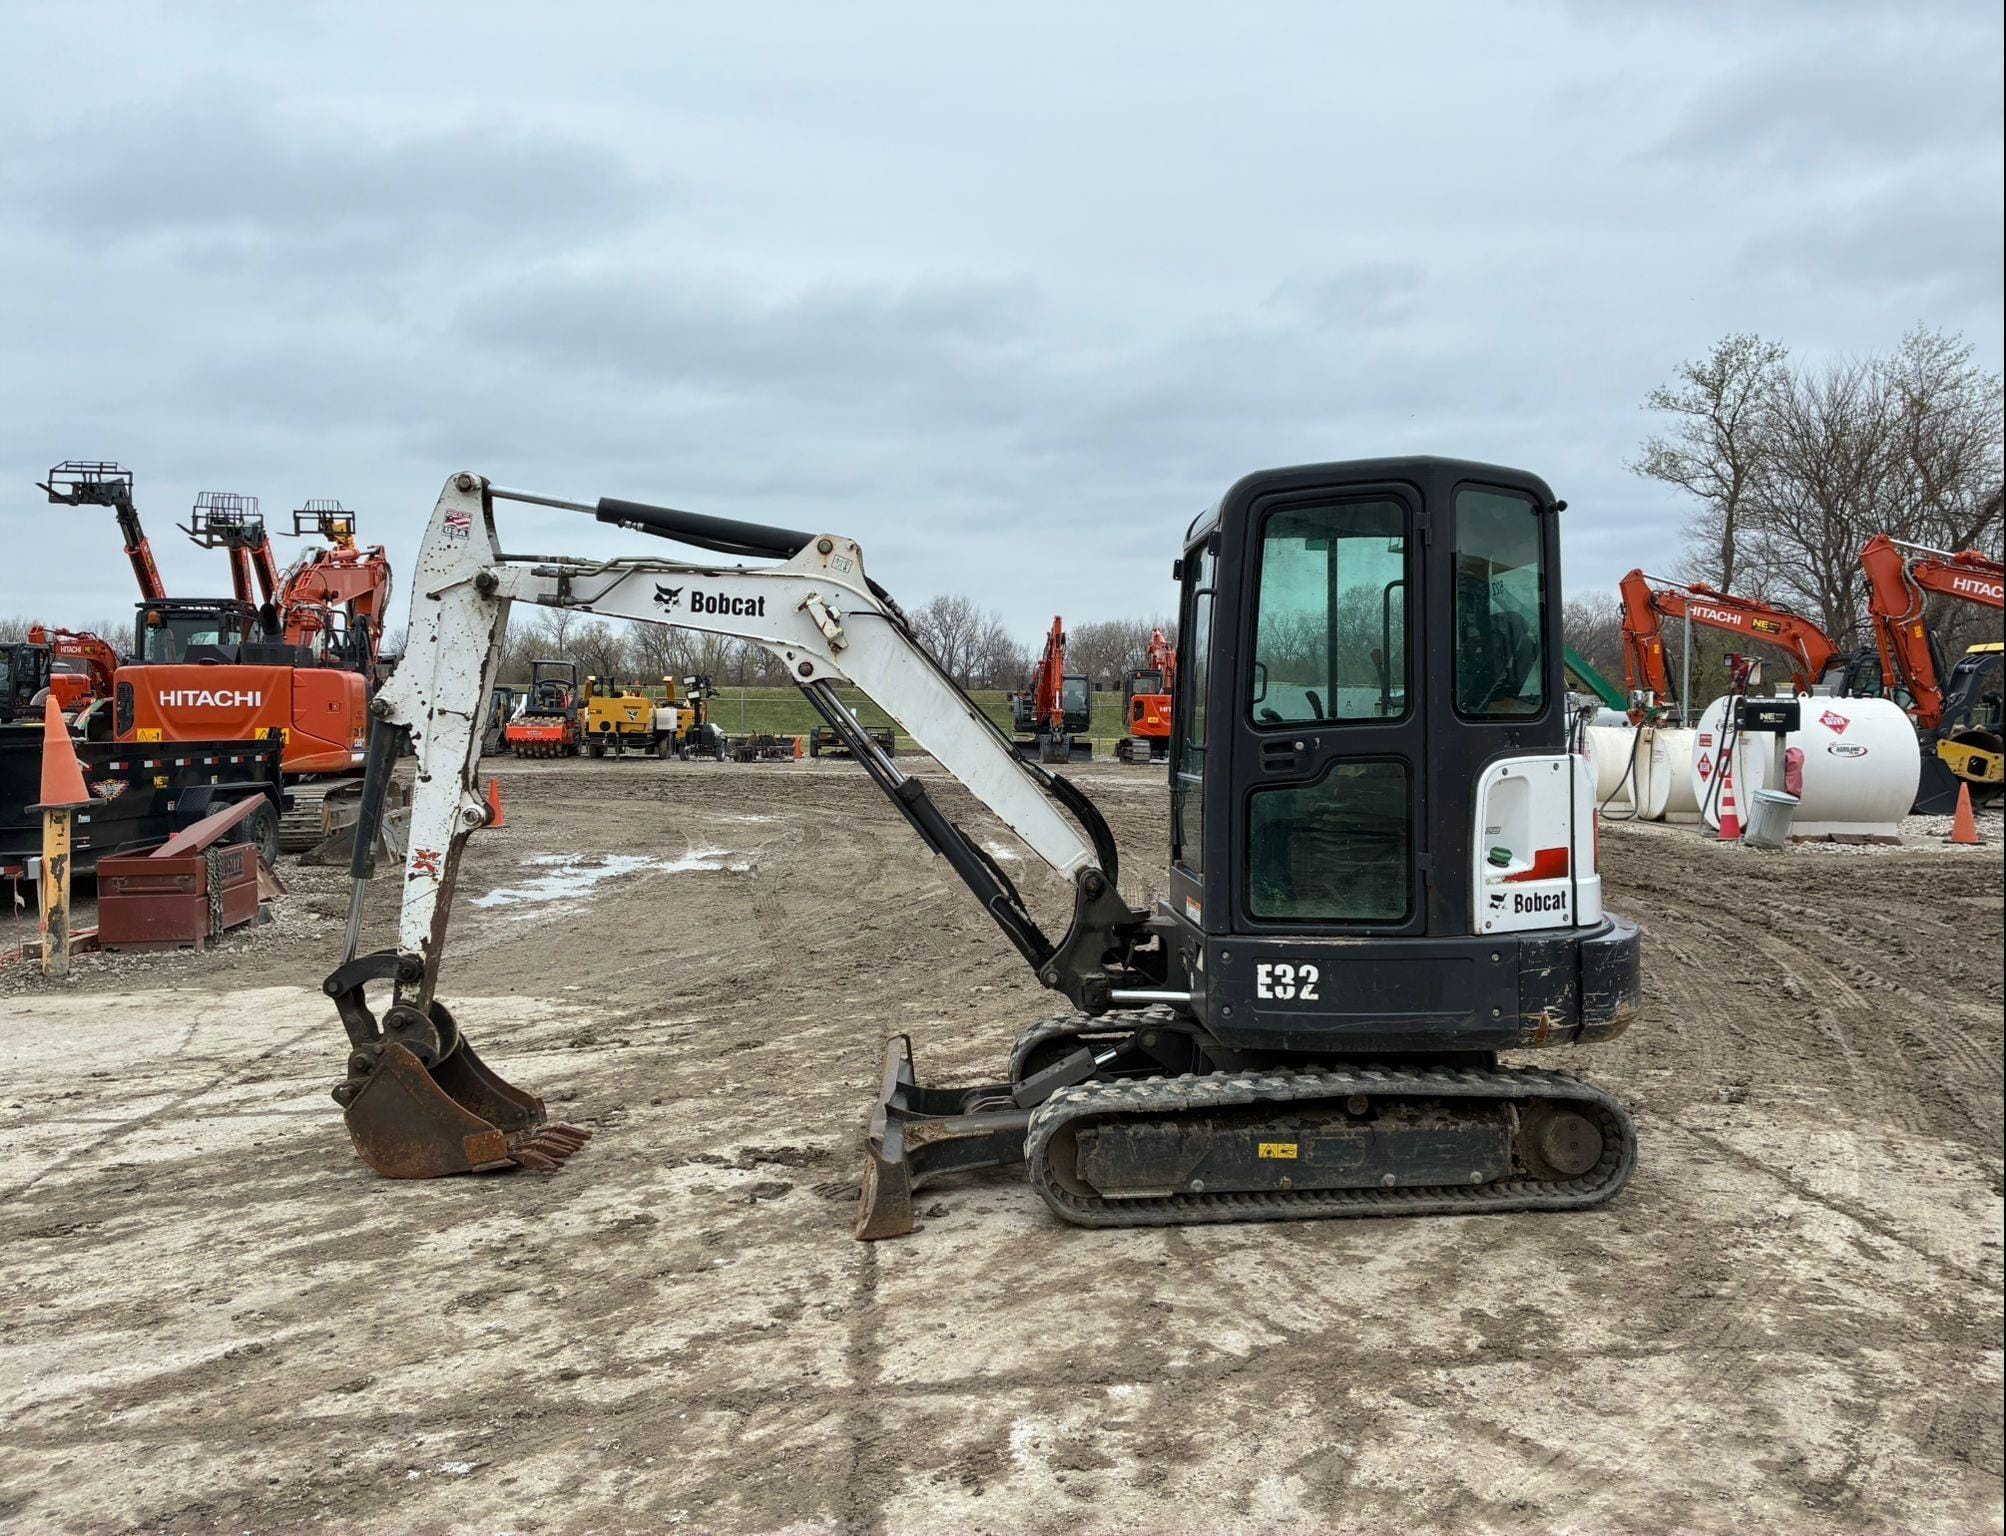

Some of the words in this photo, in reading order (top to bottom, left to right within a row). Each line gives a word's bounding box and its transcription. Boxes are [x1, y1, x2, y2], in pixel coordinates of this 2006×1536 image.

[1952, 576, 2005, 599] HITAC
[691, 590, 765, 617] Bobcat
[1689, 606, 1742, 625] HITACHI
[60, 645, 82, 653] HITACHI
[159, 690, 261, 707] HITACHI
[1514, 890, 1567, 914] Bobcat
[1256, 963, 1319, 1000] E32
